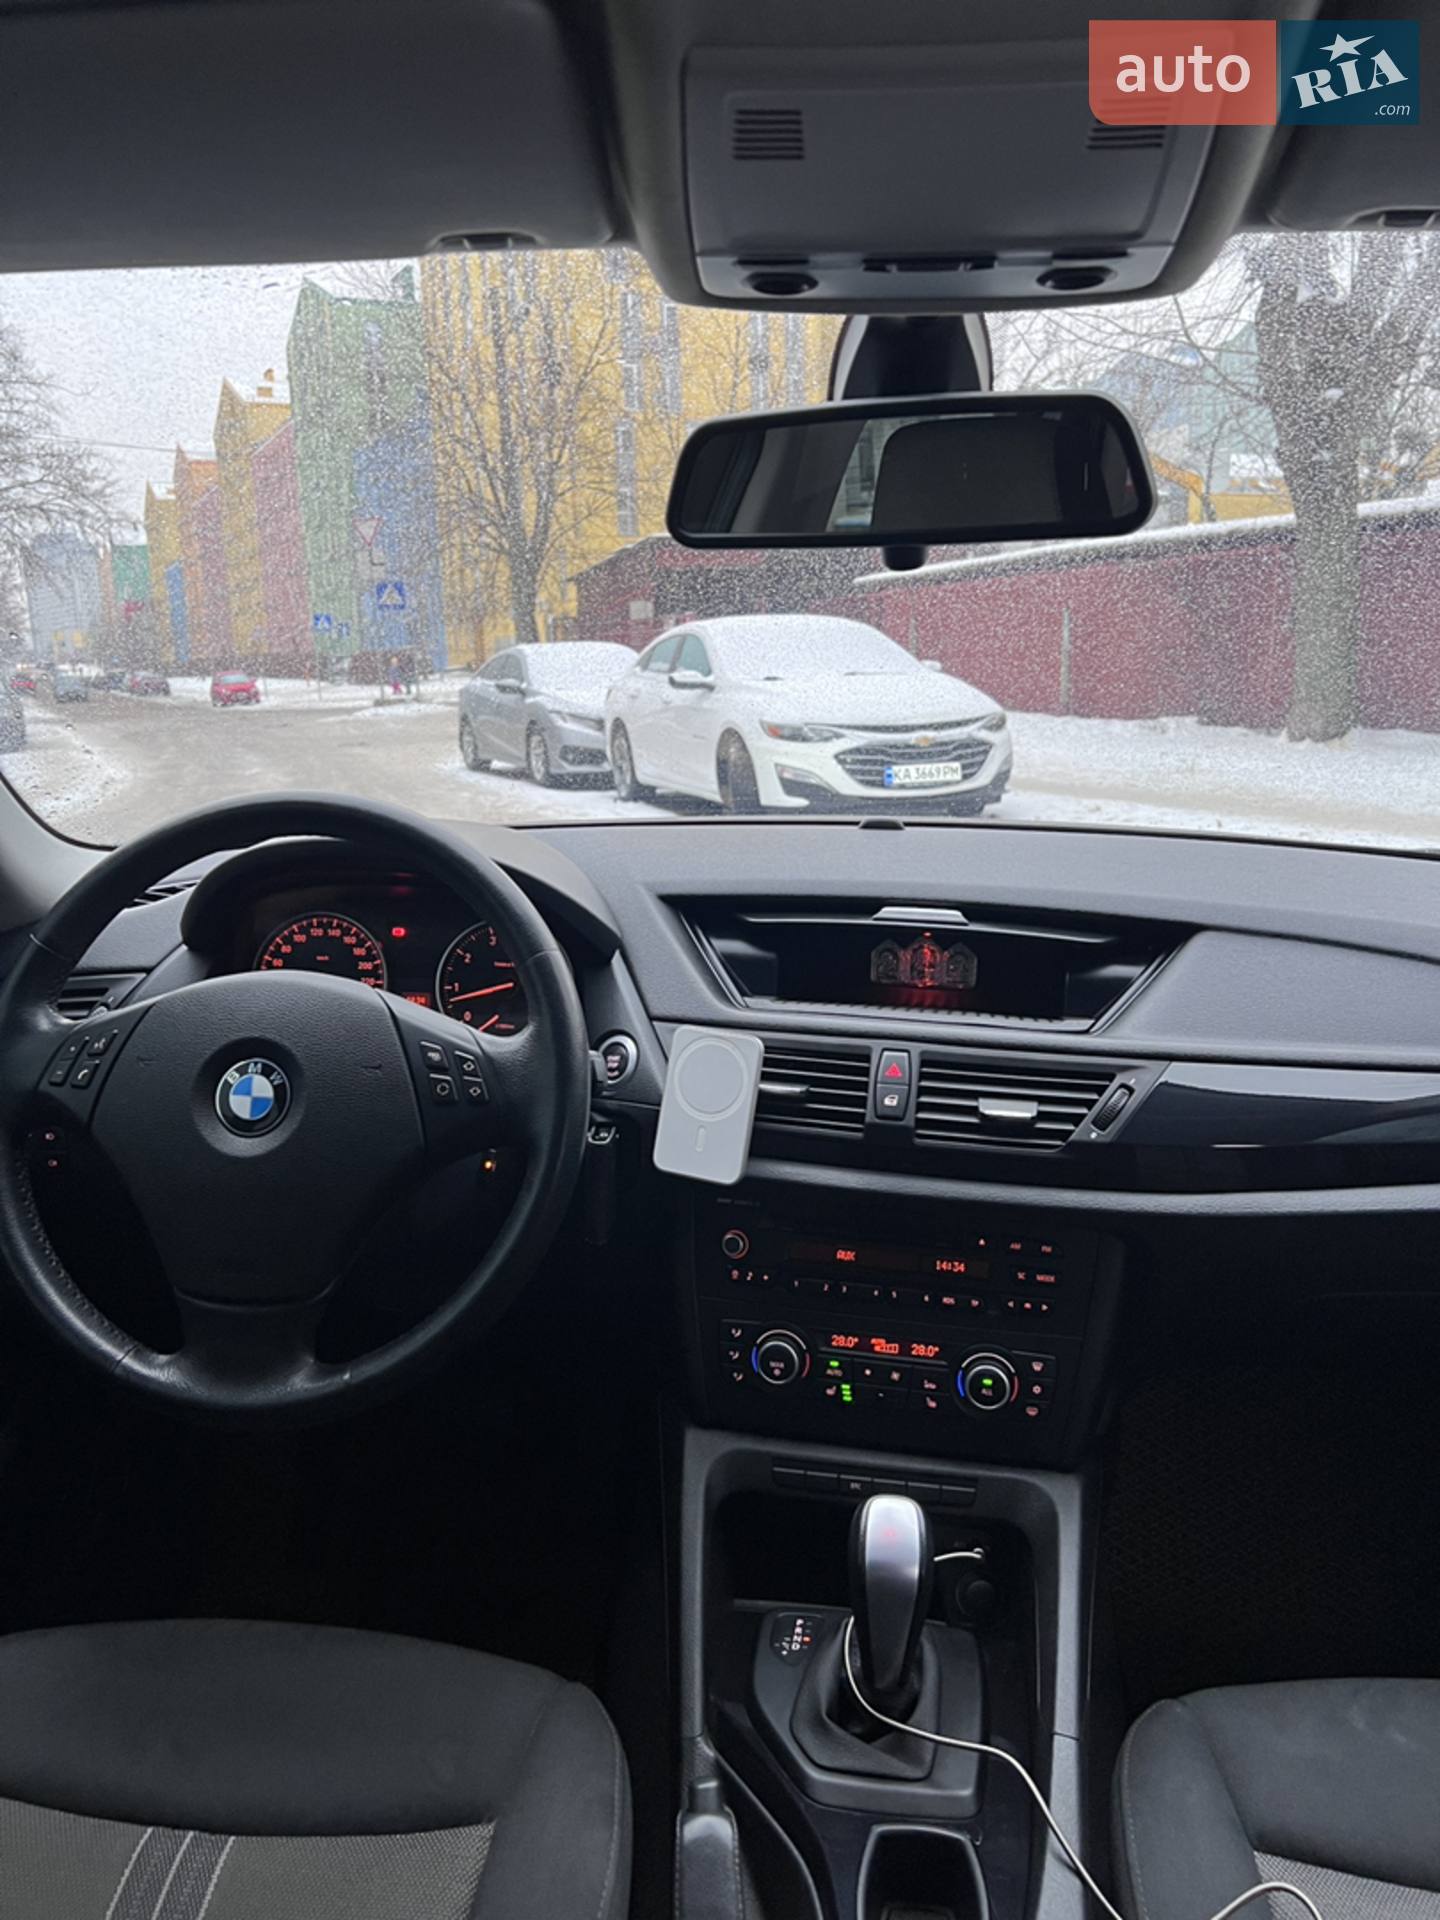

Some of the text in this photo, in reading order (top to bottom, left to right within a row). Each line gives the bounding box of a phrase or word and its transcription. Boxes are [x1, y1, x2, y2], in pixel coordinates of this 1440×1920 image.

[893, 767, 912, 781] KA
[464, 952, 472, 964] 2
[463, 1011, 472, 1022] 0
[226, 1062, 283, 1085] BMW
[837, 1250, 856, 1261] AUX
[935, 1260, 965, 1273] 14:34
